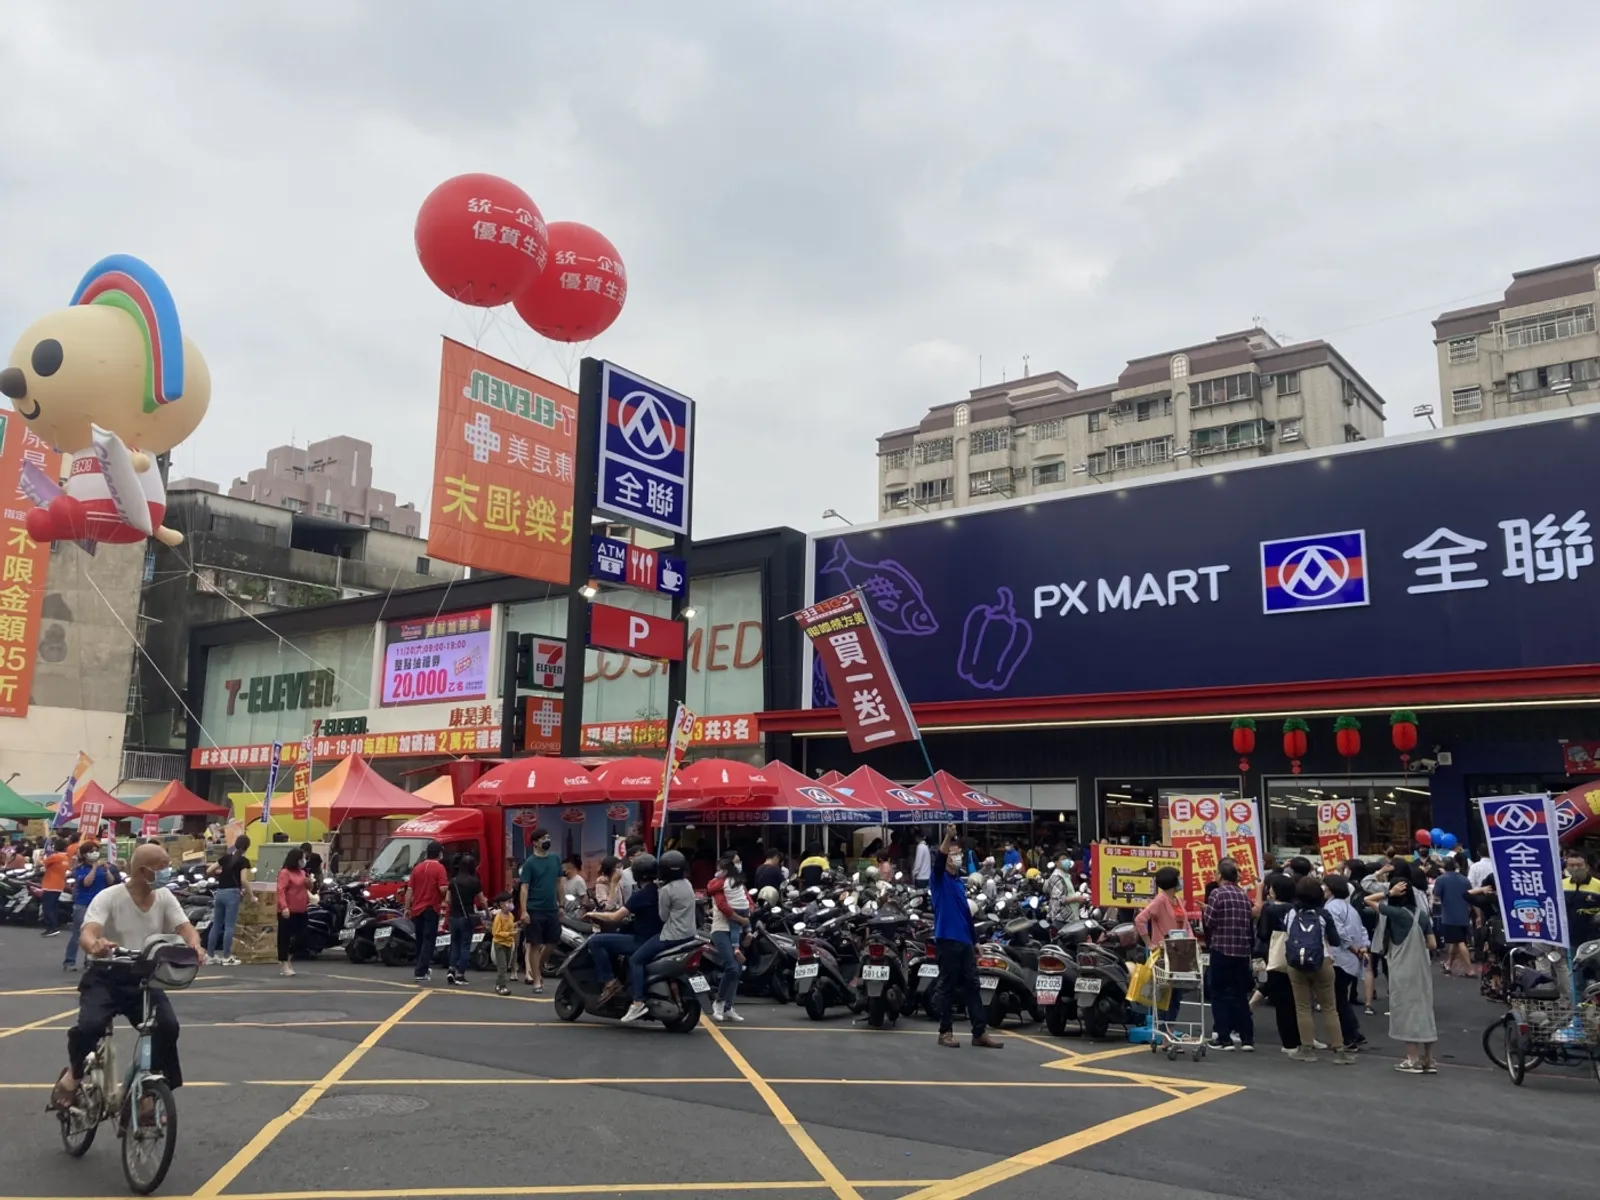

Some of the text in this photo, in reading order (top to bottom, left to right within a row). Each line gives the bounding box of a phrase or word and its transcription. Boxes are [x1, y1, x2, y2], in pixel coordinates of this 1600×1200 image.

[614, 471, 674, 518] 全聯
[597, 541, 625, 560] ATM
[1403, 509, 1595, 595] 全聯
[1035, 564, 1231, 619] PX MART
[629, 616, 650, 648] P
[225, 667, 336, 716] 7-ELEVEN
[392, 668, 447, 699] 20,000
[449, 703, 493, 728] 康是美
[530, 740, 561, 750] COSMED
